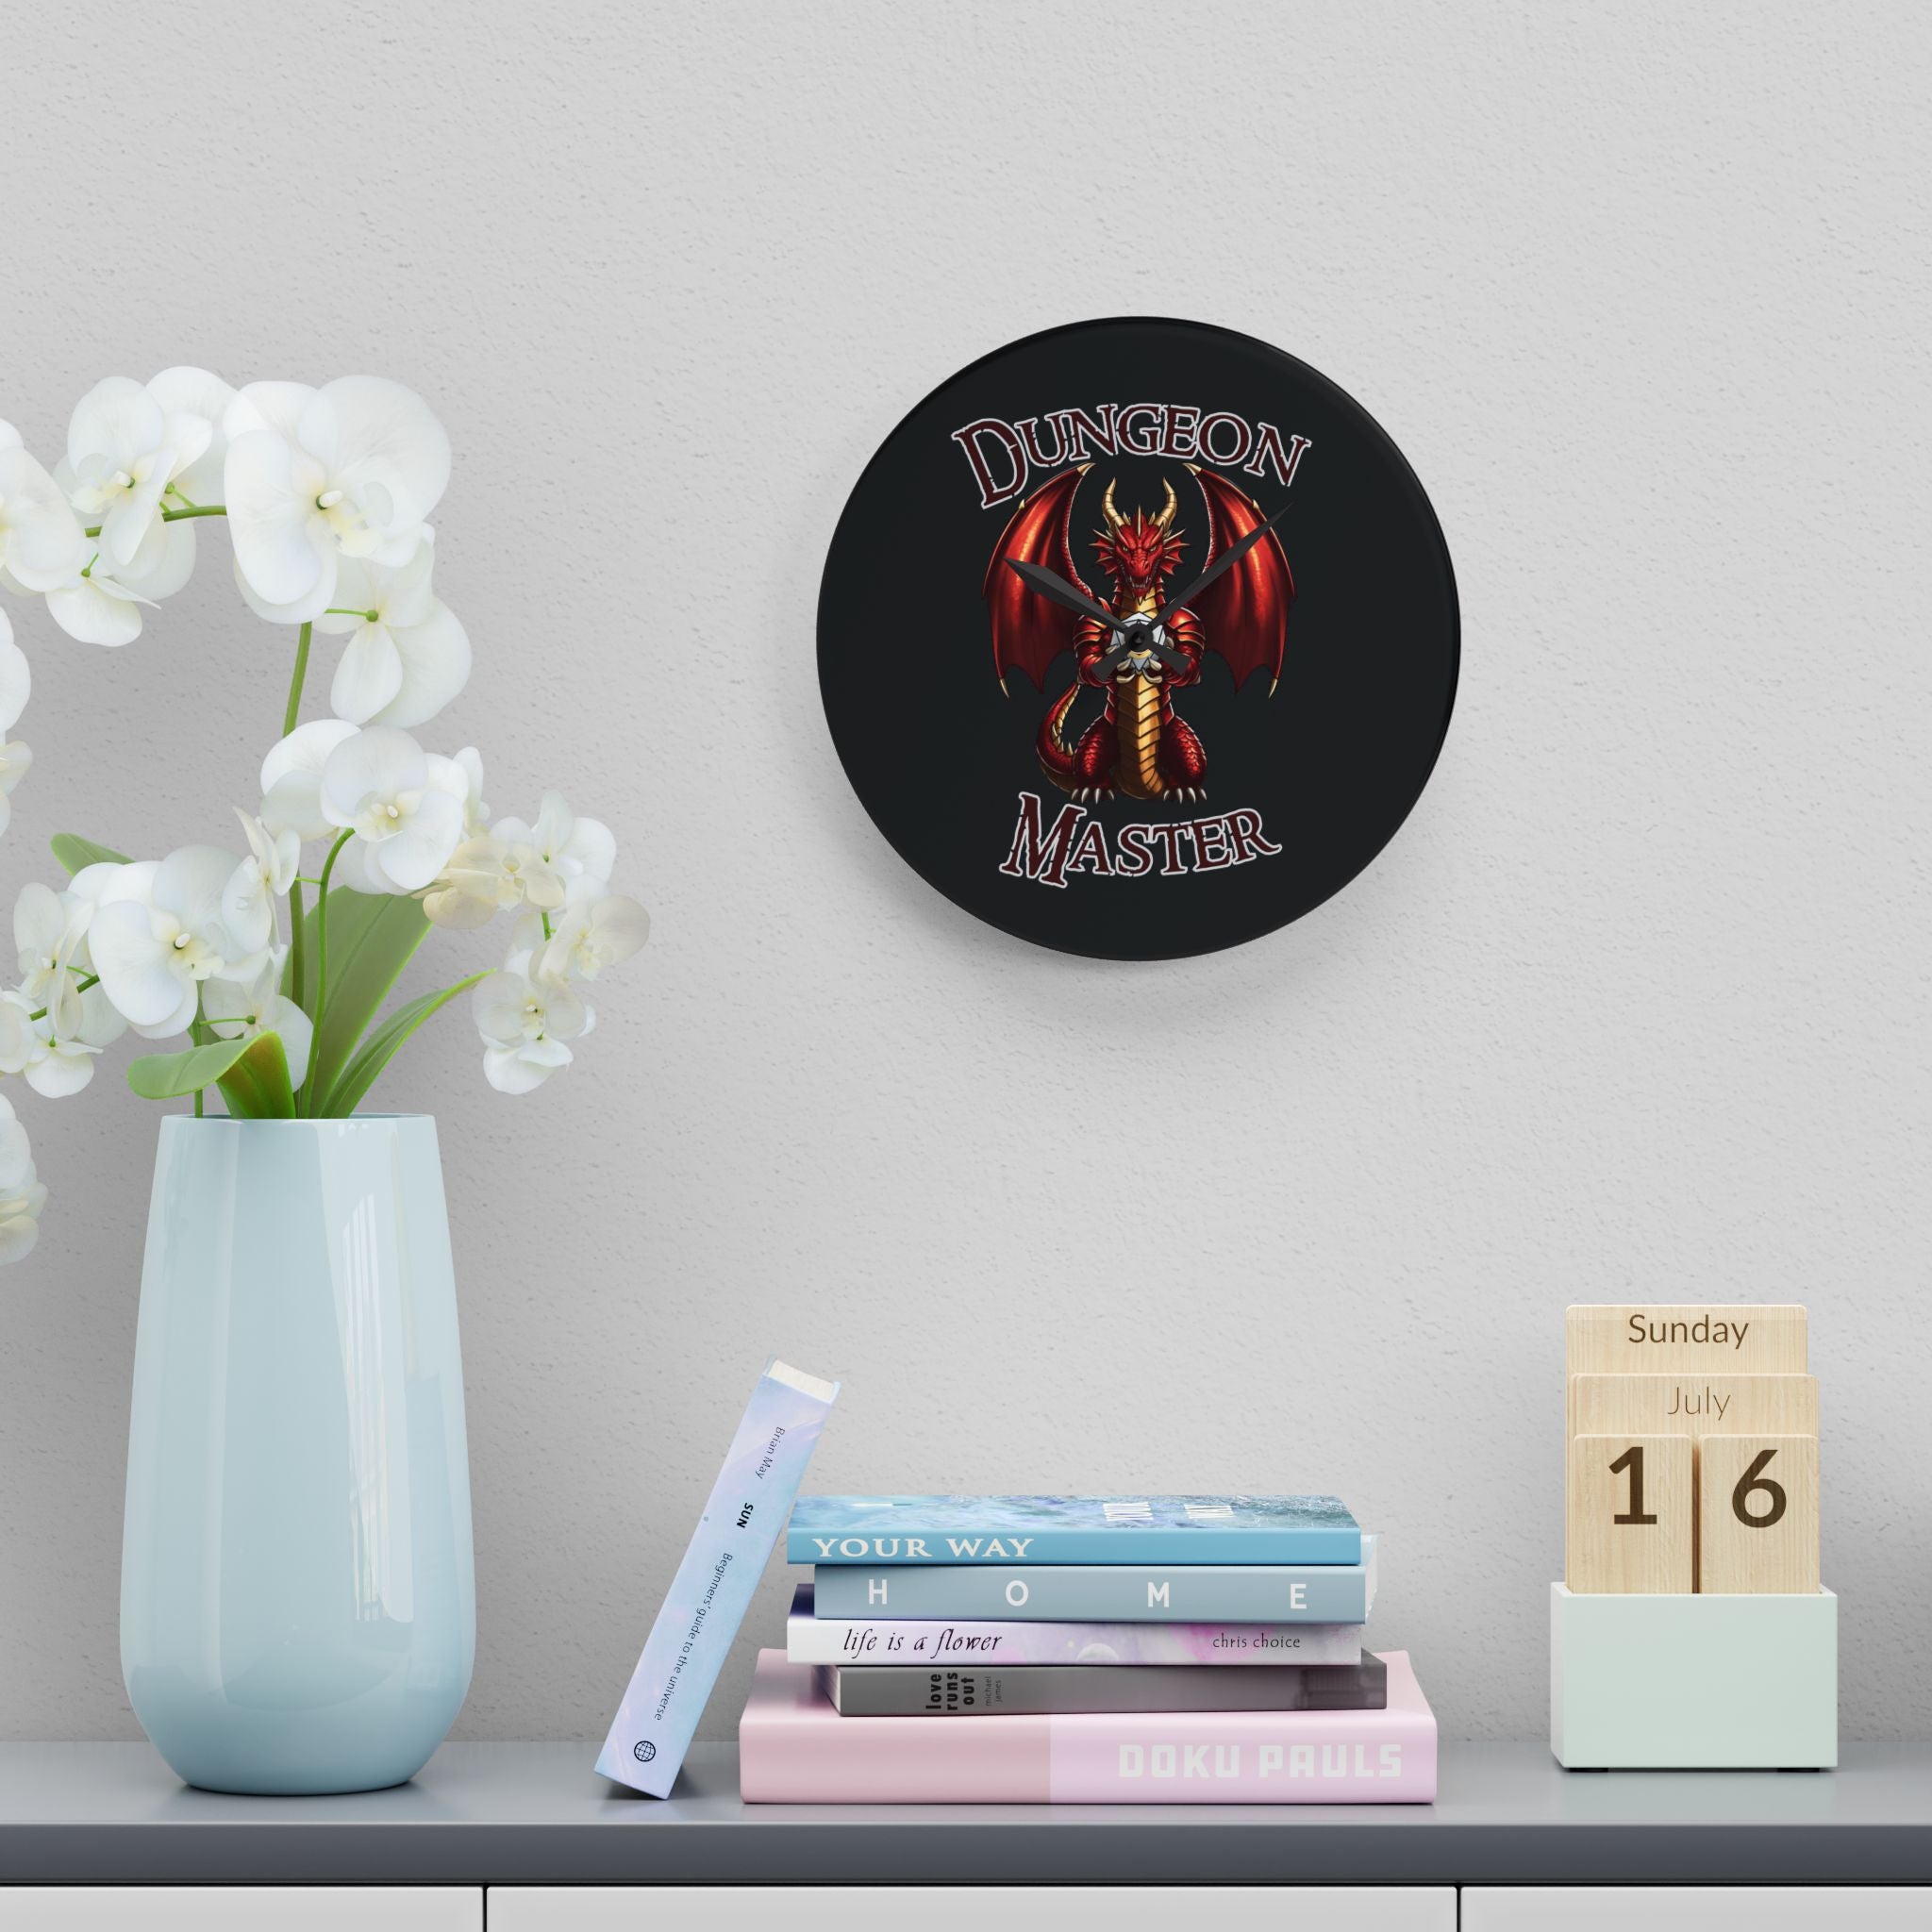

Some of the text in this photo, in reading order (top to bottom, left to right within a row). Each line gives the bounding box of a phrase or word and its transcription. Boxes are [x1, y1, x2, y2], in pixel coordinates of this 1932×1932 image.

[951, 403, 1312, 509] DUNGEON
[999, 791, 1282, 888] MASTER
[1628, 1314, 1749, 1350] Sunday
[1667, 1386, 1731, 1421] July
[755, 1426, 786, 1479] Brian May
[737, 1503, 754, 1528] SUN
[812, 1539, 1034, 1557] YOUR WAY
[654, 1552, 733, 1721] Beginners' guide to the universe
[843, 1628, 1003, 1659] life is a flower
[1212, 1632, 1301, 1648] chris choice
[925, 1674, 941, 1709] love
[946, 1672, 958, 1710] runs
[960, 1677, 974, 1706] out
[984, 1676, 992, 1707] michael
[1119, 1744, 1403, 1777] DOKU PAULS
